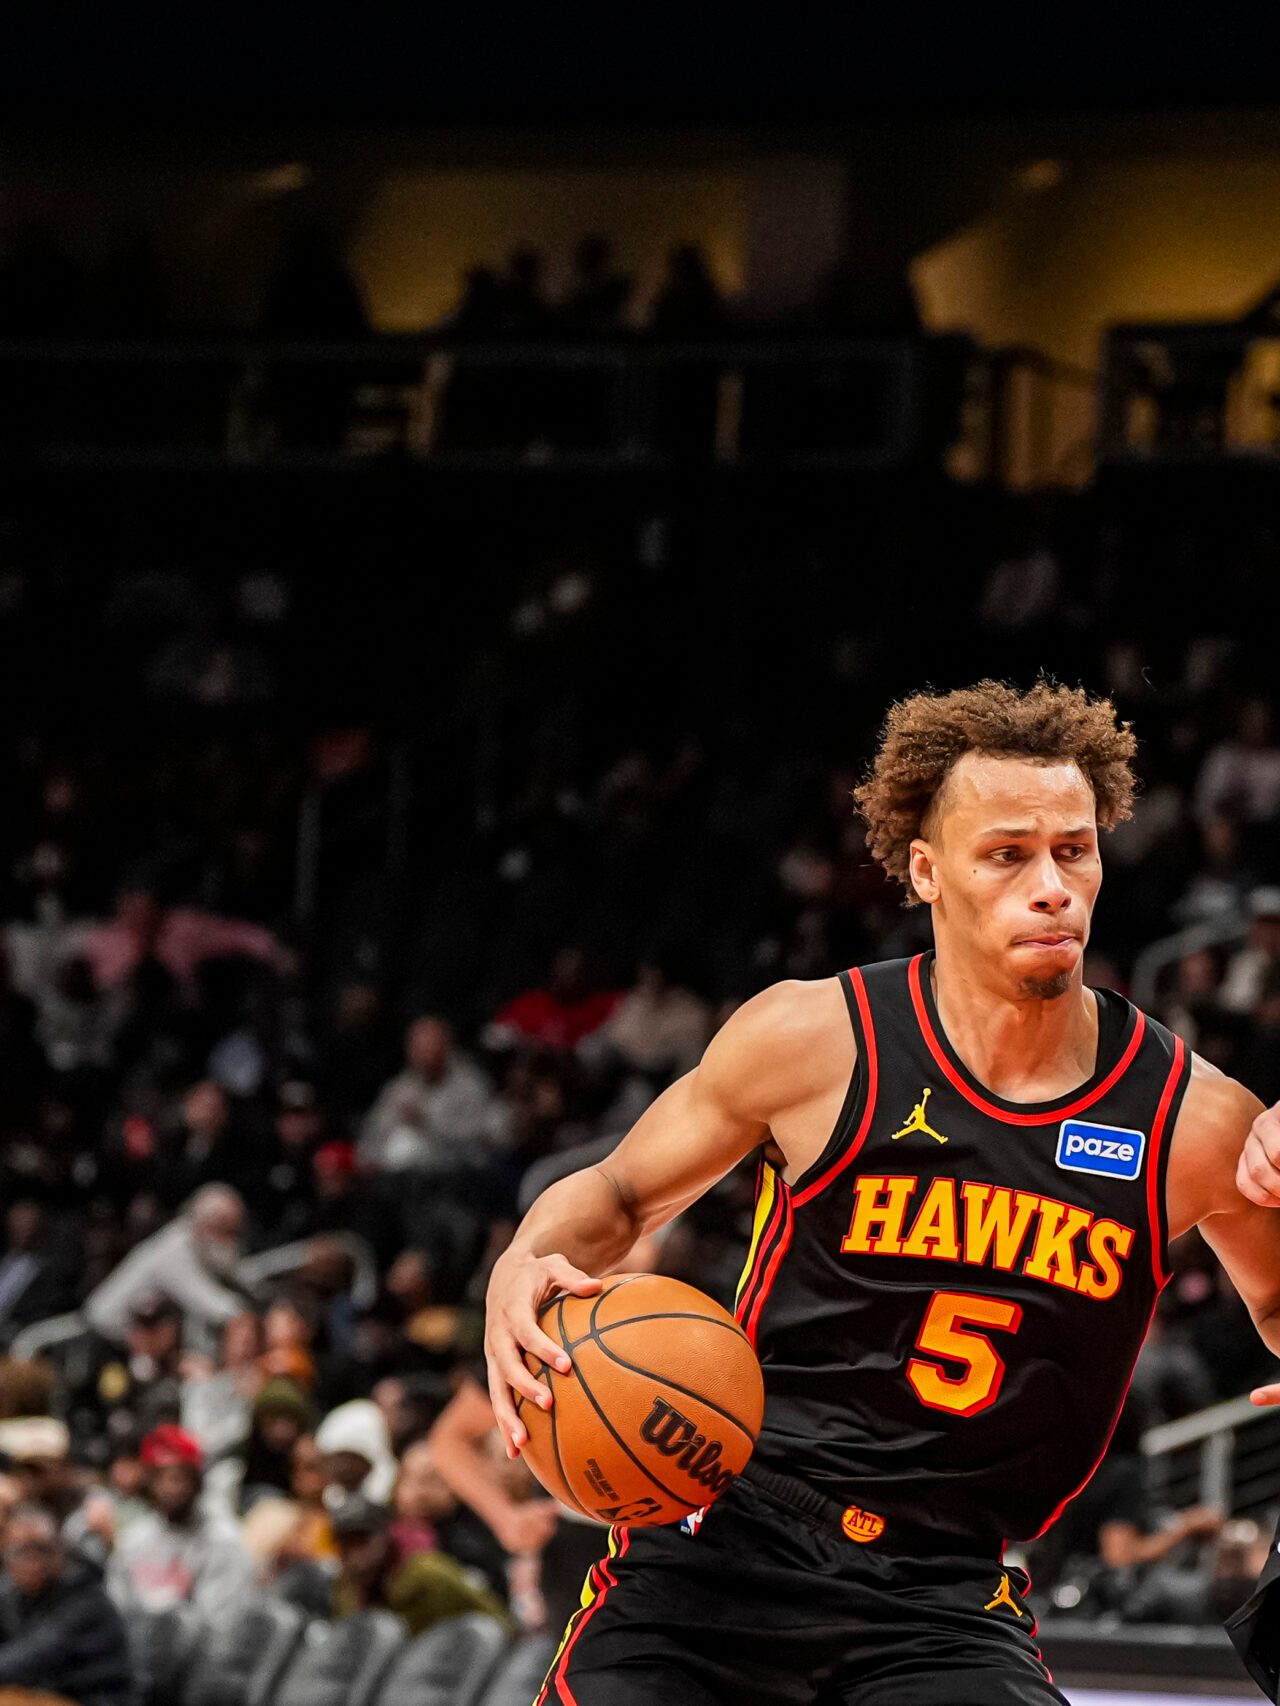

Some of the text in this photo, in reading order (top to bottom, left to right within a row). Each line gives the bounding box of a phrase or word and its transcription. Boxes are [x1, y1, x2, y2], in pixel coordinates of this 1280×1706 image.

[1065, 1133, 1135, 1163] paze
[840, 1174, 1136, 1300] HAWKS
[905, 1290, 1024, 1418] 5
[640, 1395, 735, 1494] Wilso
[846, 1510, 878, 1534] ATL
